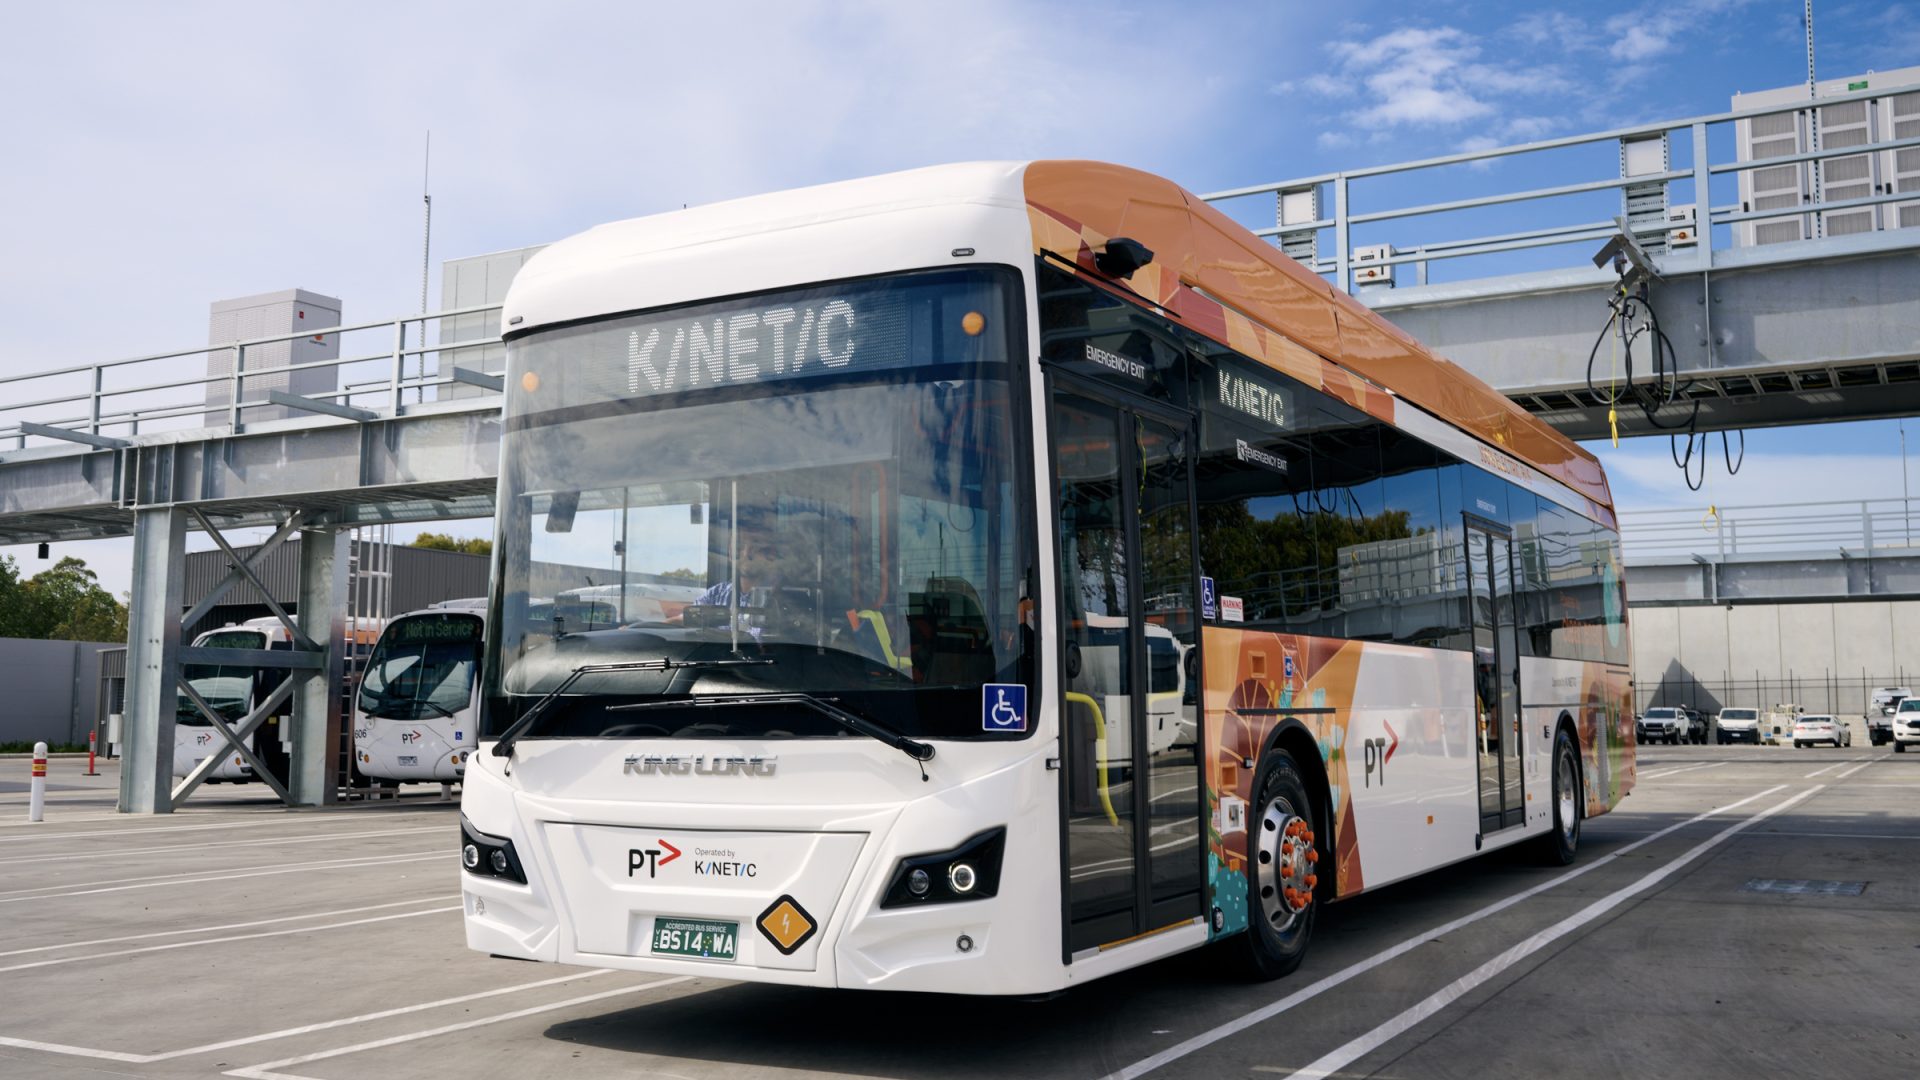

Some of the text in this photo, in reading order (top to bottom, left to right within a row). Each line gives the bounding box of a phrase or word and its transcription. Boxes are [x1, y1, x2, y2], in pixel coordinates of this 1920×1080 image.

[1086, 344, 1145, 380] EMERGENCY EXIT
[1247, 447, 1288, 471] EMERGENCY EXIT
[406, 622, 423, 637] Not
[435, 622, 475, 637] Service
[623, 754, 778, 777] KING LONG
[628, 848, 661, 878] PT
[695, 847, 735, 859] Operated by
[664, 922, 727, 934] ACCREDITED BUS SERVICE
